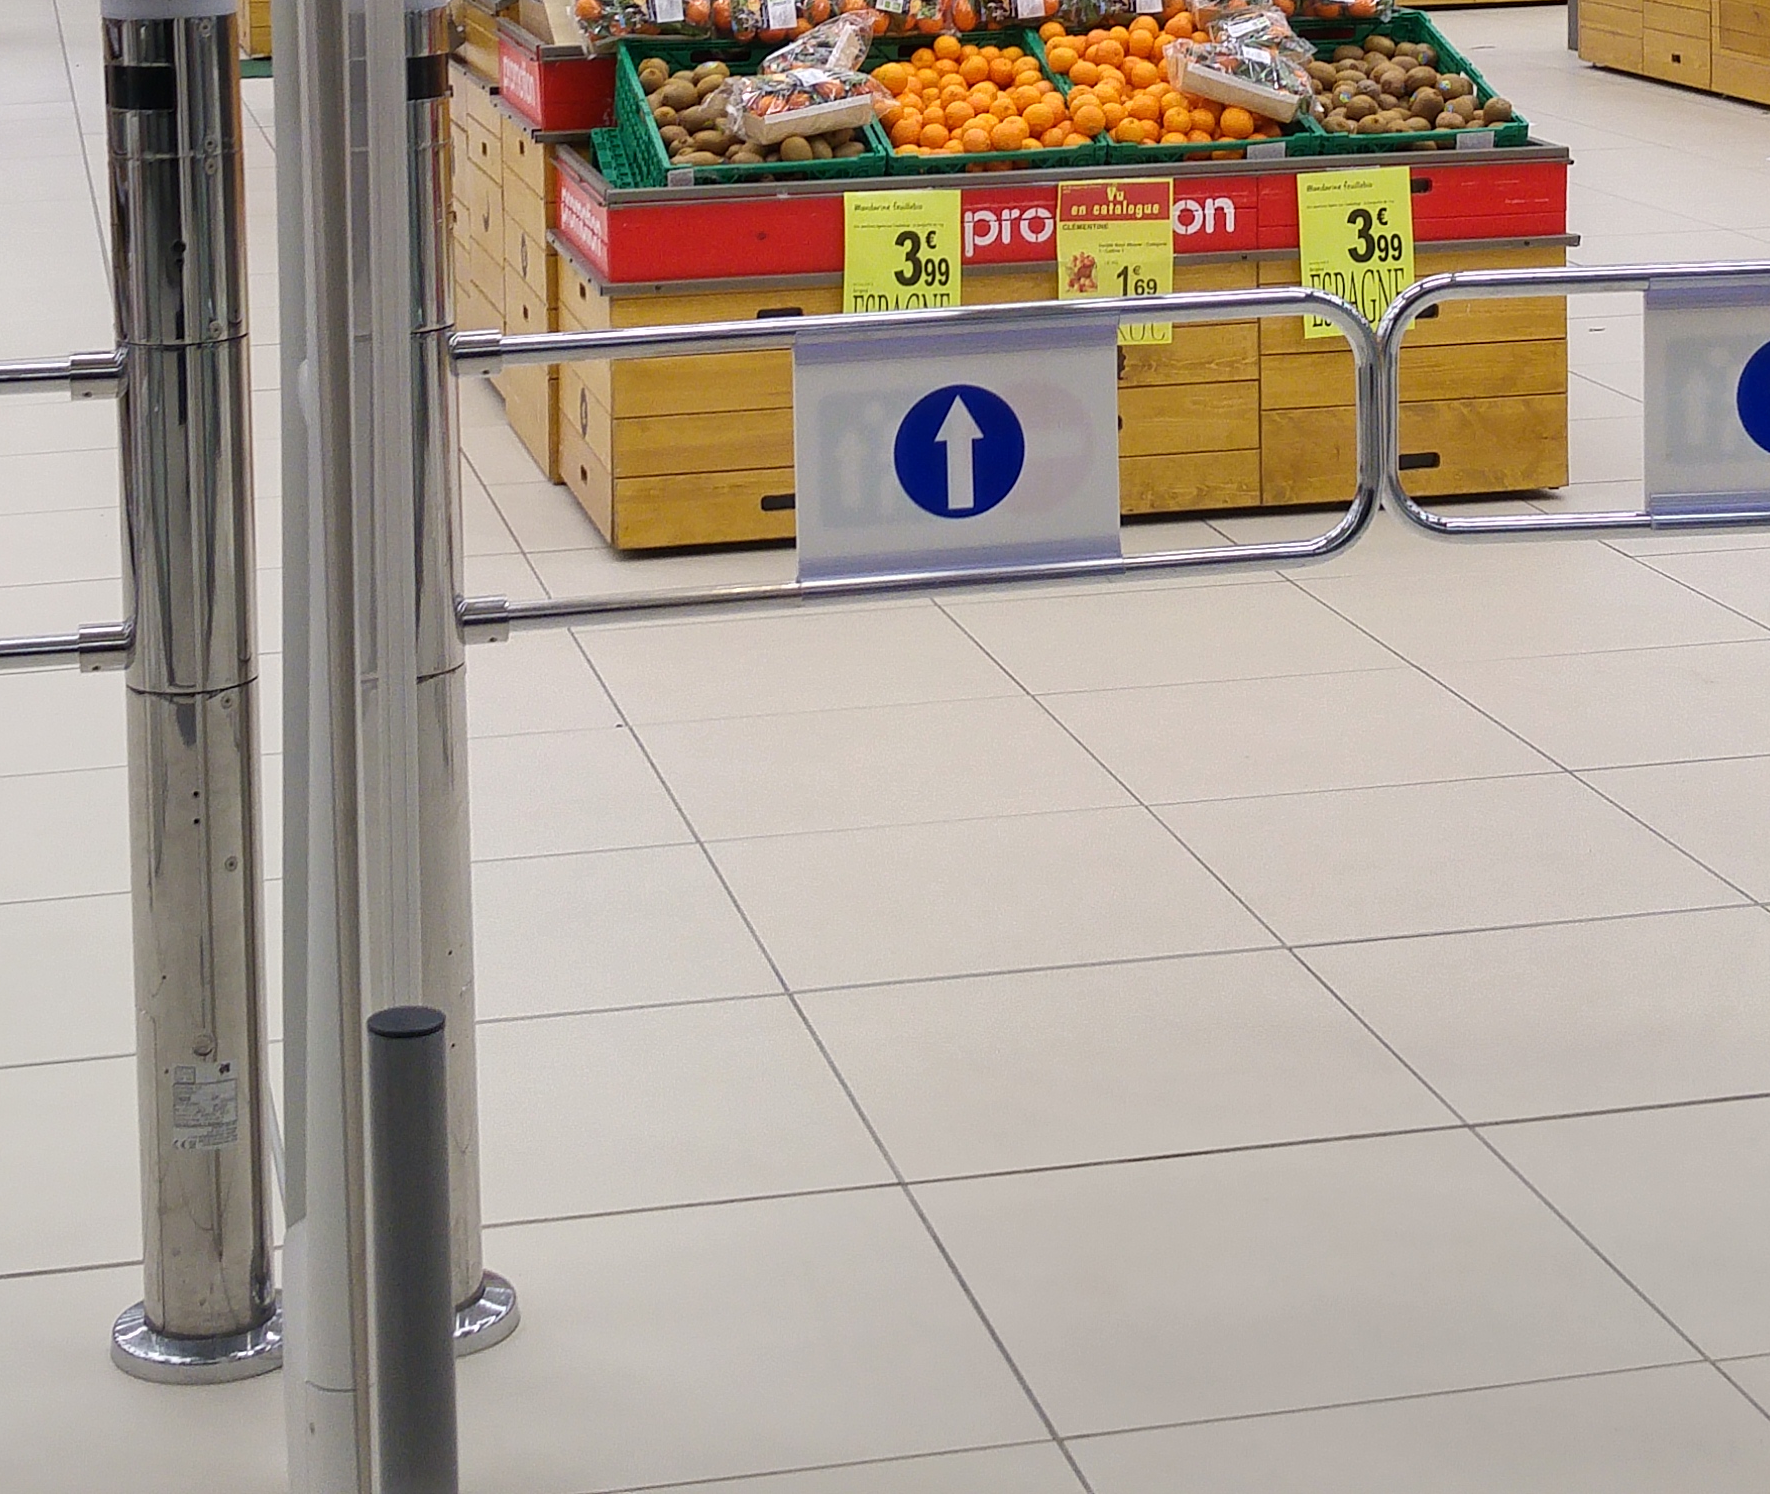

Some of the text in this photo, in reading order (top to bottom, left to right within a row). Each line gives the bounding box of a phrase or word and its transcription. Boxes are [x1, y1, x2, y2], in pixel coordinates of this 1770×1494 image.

[1107, 186, 1124, 202] Vu
[1071, 200, 1160, 218] en catalogue
